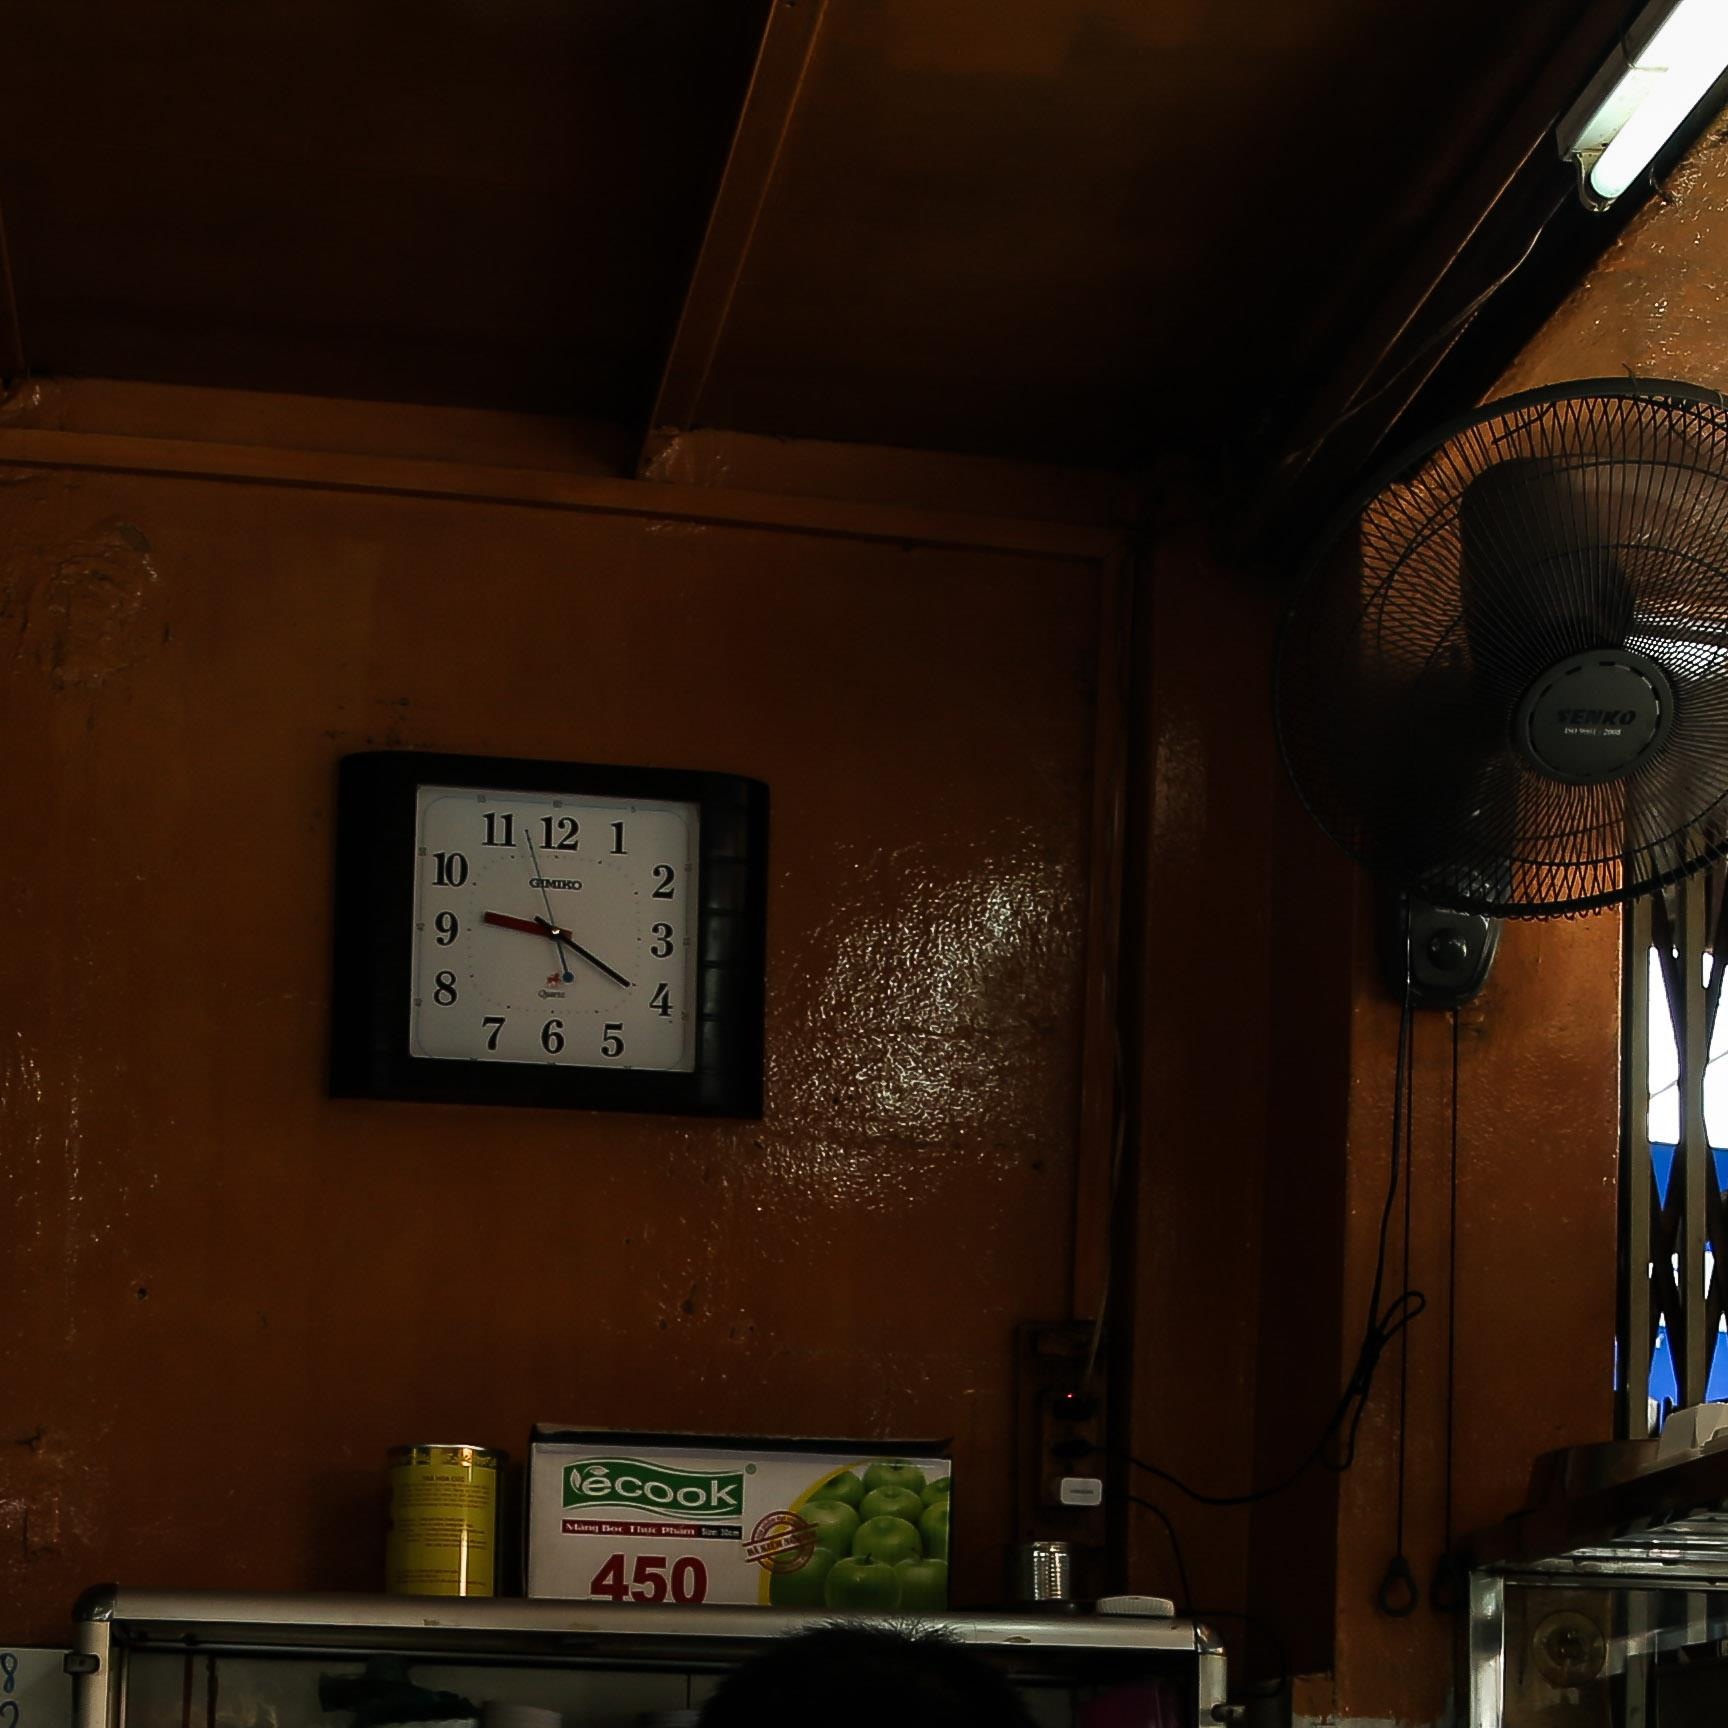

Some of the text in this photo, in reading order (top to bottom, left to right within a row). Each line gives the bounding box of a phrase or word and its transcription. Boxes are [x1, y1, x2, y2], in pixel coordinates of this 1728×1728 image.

[1557, 709, 1637, 726] SENKO
[482, 812, 516, 847] 11
[540, 816, 579, 851] 12
[610, 821, 628, 855] 1
[432, 852, 469, 887] 10
[528, 877, 583, 891] GIMIKO
[652, 864, 675, 899] 2
[435, 911, 459, 946] 9
[650, 922, 674, 958] 3
[433, 970, 458, 1006] 8
[537, 989, 566, 1000] Quartz
[649, 982, 673, 1017] 4
[482, 1016, 506, 1051] 7
[541, 1018, 565, 1054] 6
[600, 1022, 625, 1057] 5
[590, 1553, 708, 1604] 450
